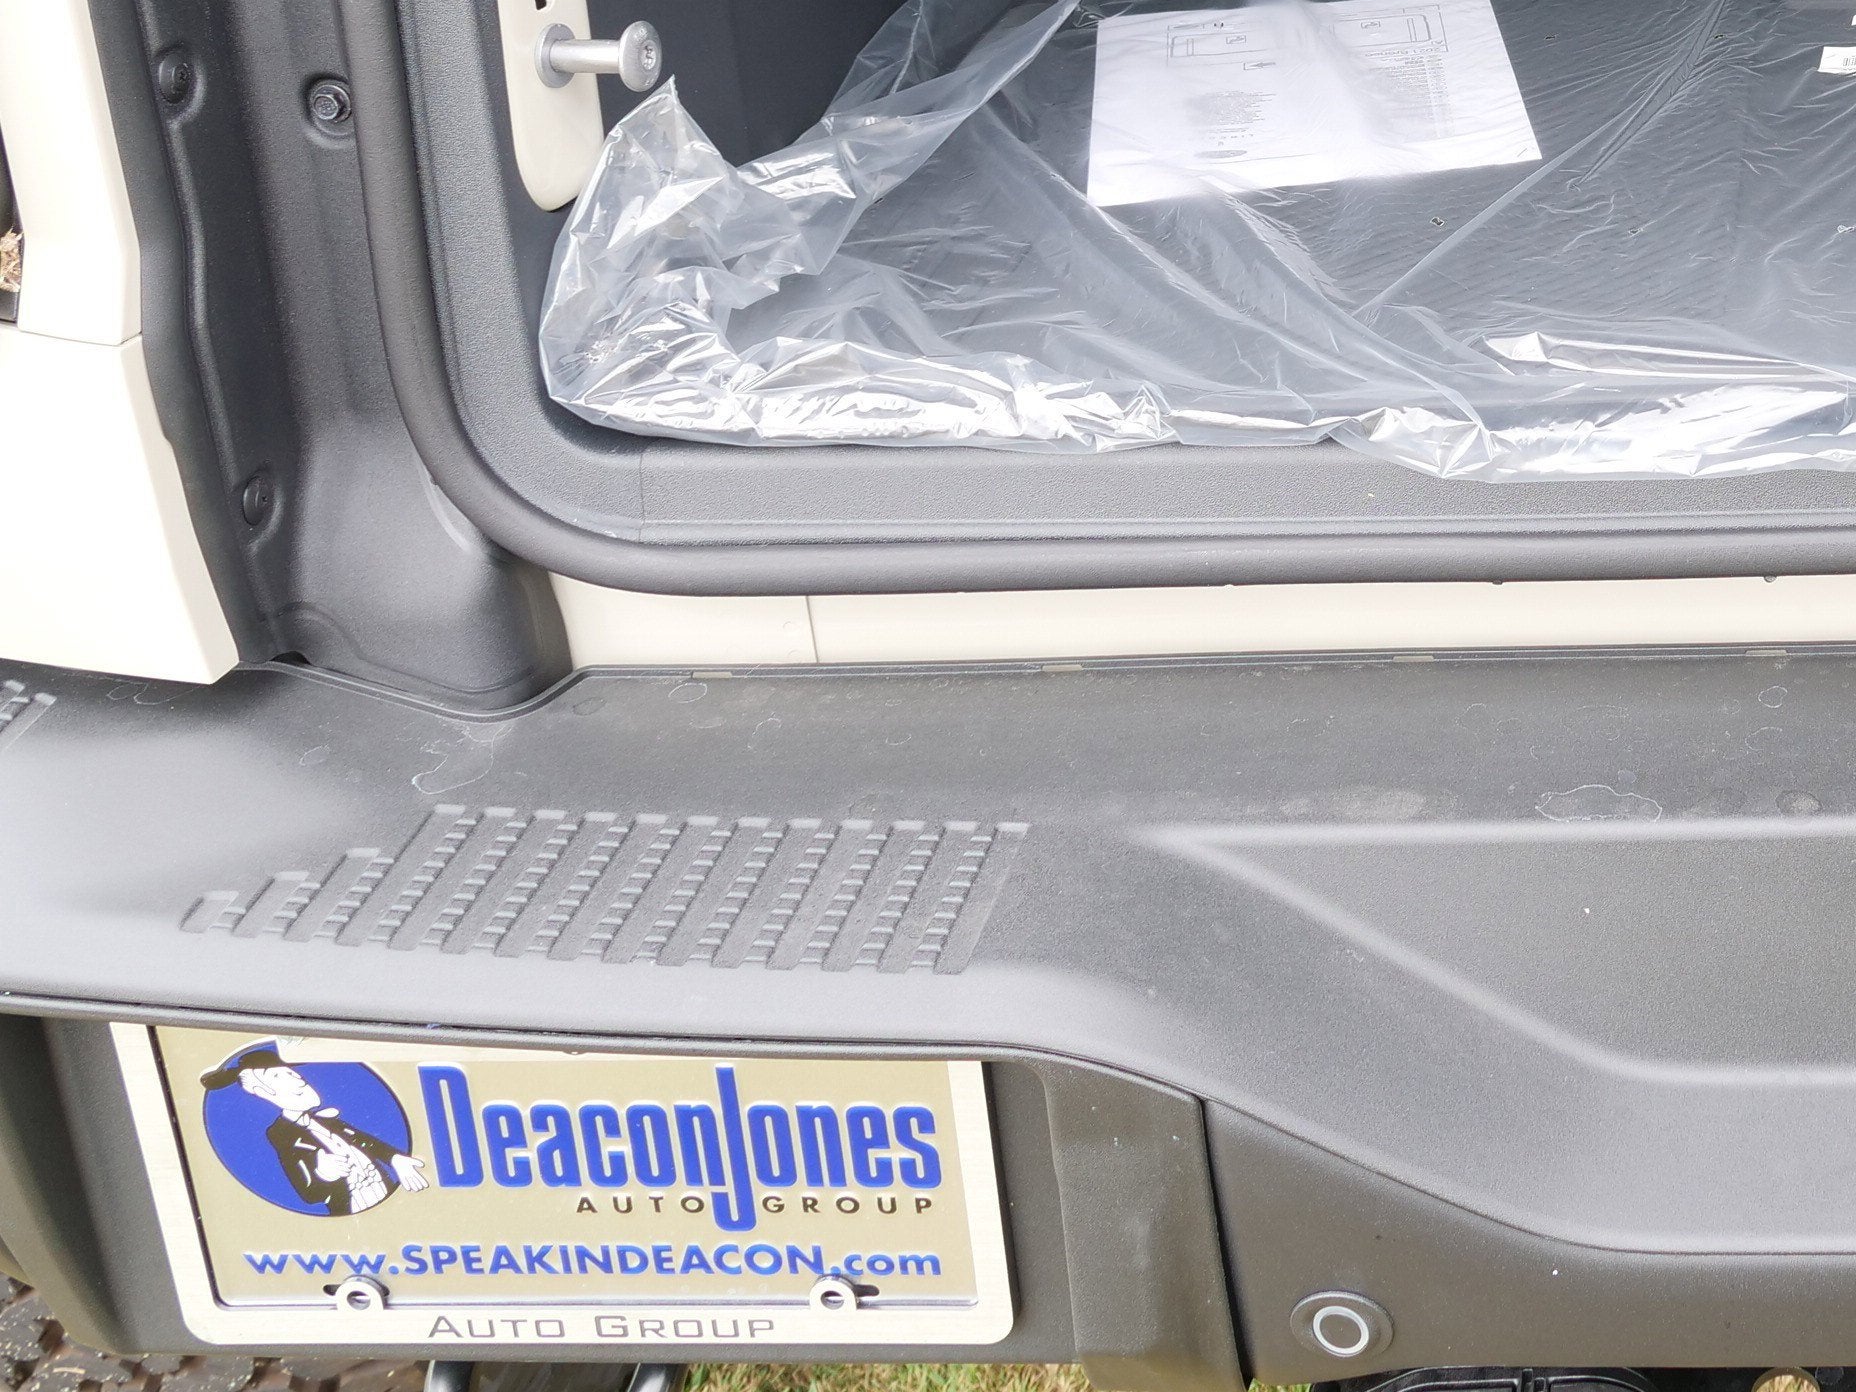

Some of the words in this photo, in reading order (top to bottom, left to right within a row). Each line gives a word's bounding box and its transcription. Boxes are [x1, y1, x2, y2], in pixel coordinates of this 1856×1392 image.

[416, 1063, 943, 1233] DeaconJones
[576, 1195, 704, 1216] AUTO
[761, 1194, 935, 1216] GROUP
[244, 1242, 942, 1278] www.SPEAKINDEACON.com
